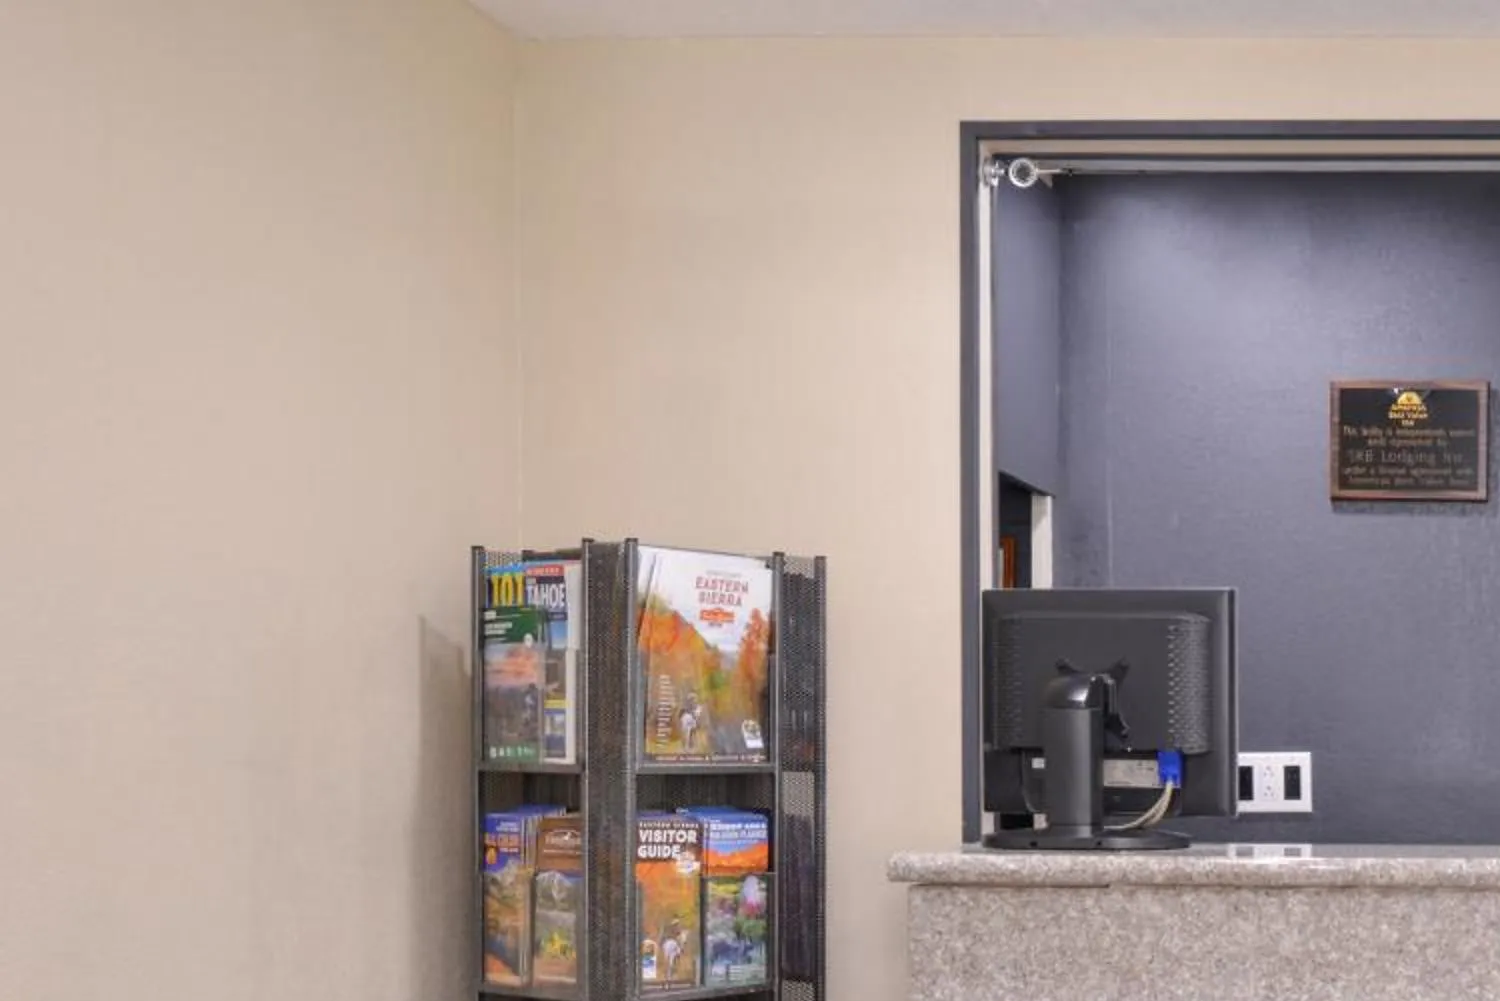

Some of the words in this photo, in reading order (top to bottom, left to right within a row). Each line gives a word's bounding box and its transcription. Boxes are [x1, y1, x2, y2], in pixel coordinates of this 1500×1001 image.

[695, 576, 748, 593] EASTERN
[526, 583, 566, 608] TAHOE
[699, 591, 743, 607] SIERRA
[638, 829, 698, 843] VISITOR
[637, 845, 682, 858] GUIDE
